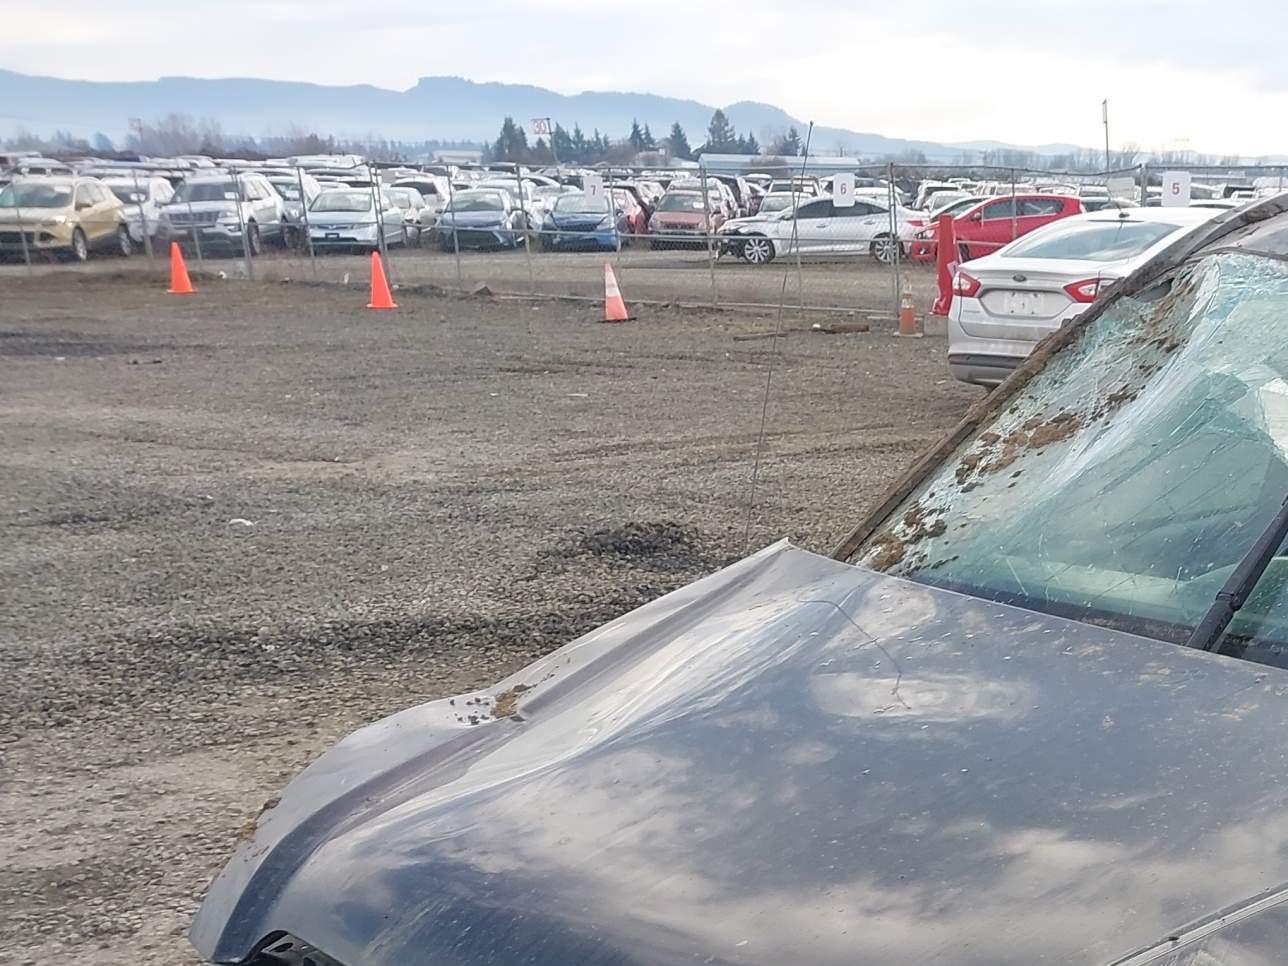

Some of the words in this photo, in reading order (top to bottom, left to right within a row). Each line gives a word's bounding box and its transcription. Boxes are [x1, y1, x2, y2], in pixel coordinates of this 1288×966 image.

[591, 184, 597, 196] 7
[840, 183, 847, 195] 6
[1172, 182, 1180, 195] 5
